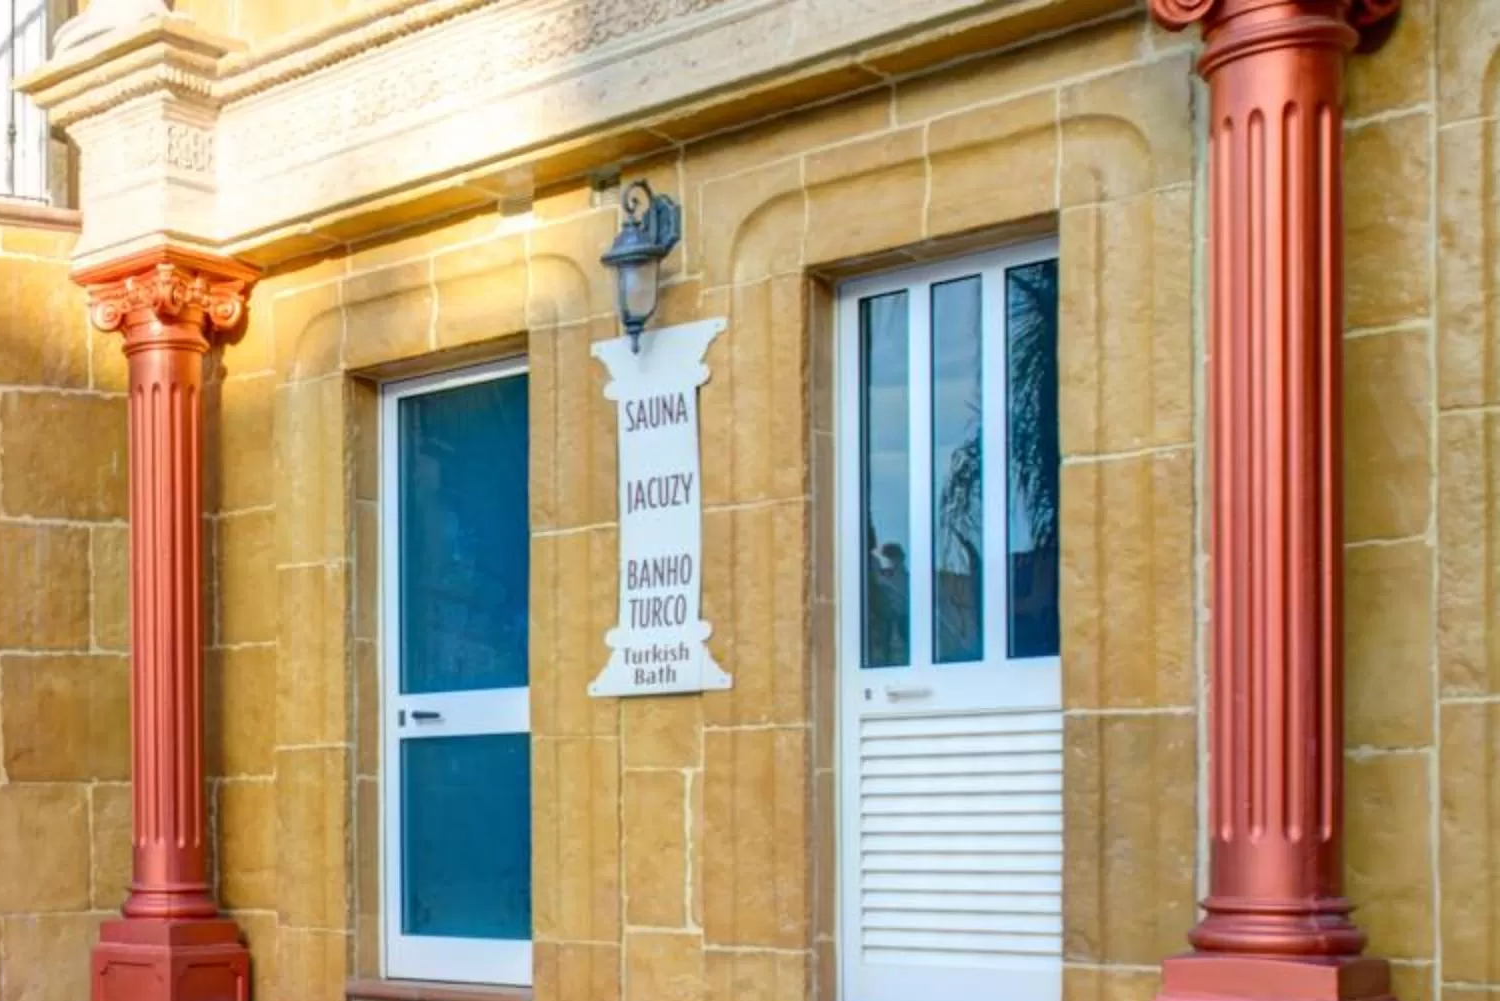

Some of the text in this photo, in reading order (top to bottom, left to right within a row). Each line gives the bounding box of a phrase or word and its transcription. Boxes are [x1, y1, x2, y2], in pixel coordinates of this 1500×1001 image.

[625, 393, 689, 432] SAUNA
[627, 553, 693, 591] BANHO
[629, 594, 687, 630] TURCO
[623, 641, 690, 665] Turkish
[634, 665, 677, 686] Bath
